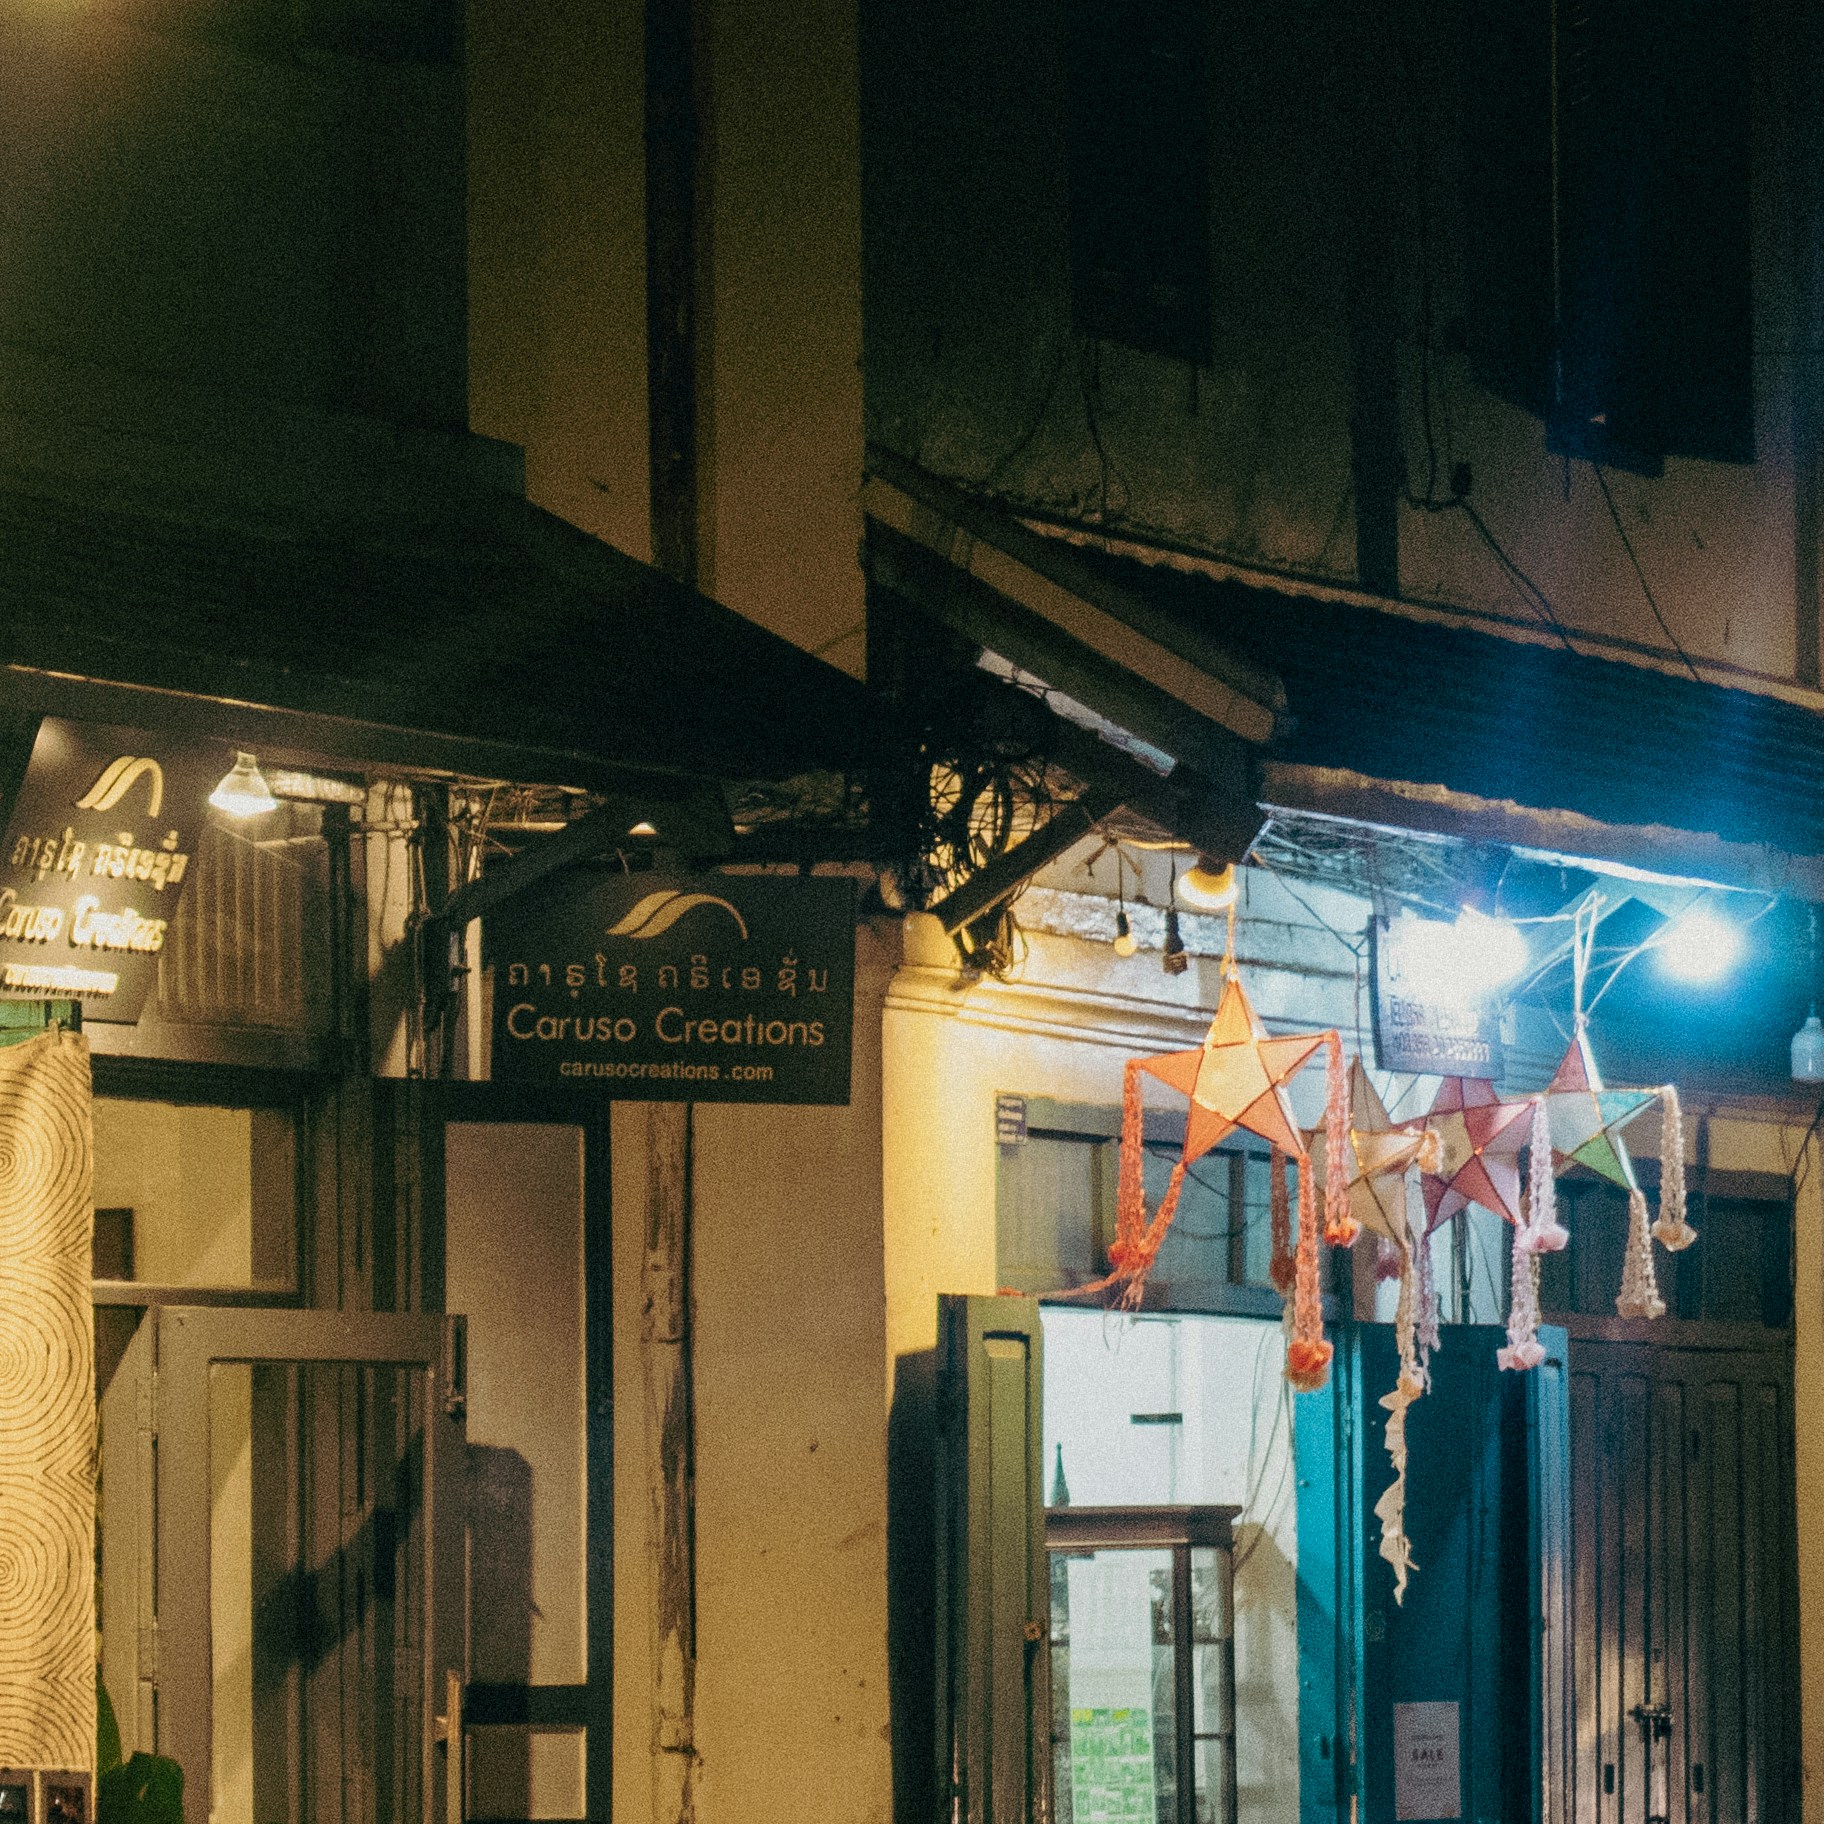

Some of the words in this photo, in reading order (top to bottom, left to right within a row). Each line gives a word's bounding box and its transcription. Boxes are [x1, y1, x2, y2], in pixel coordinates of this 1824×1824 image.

[507, 1003, 637, 1042] Caruso
[655, 1007, 826, 1047] Creations
[1412, 1749, 1444, 1761] SALE
